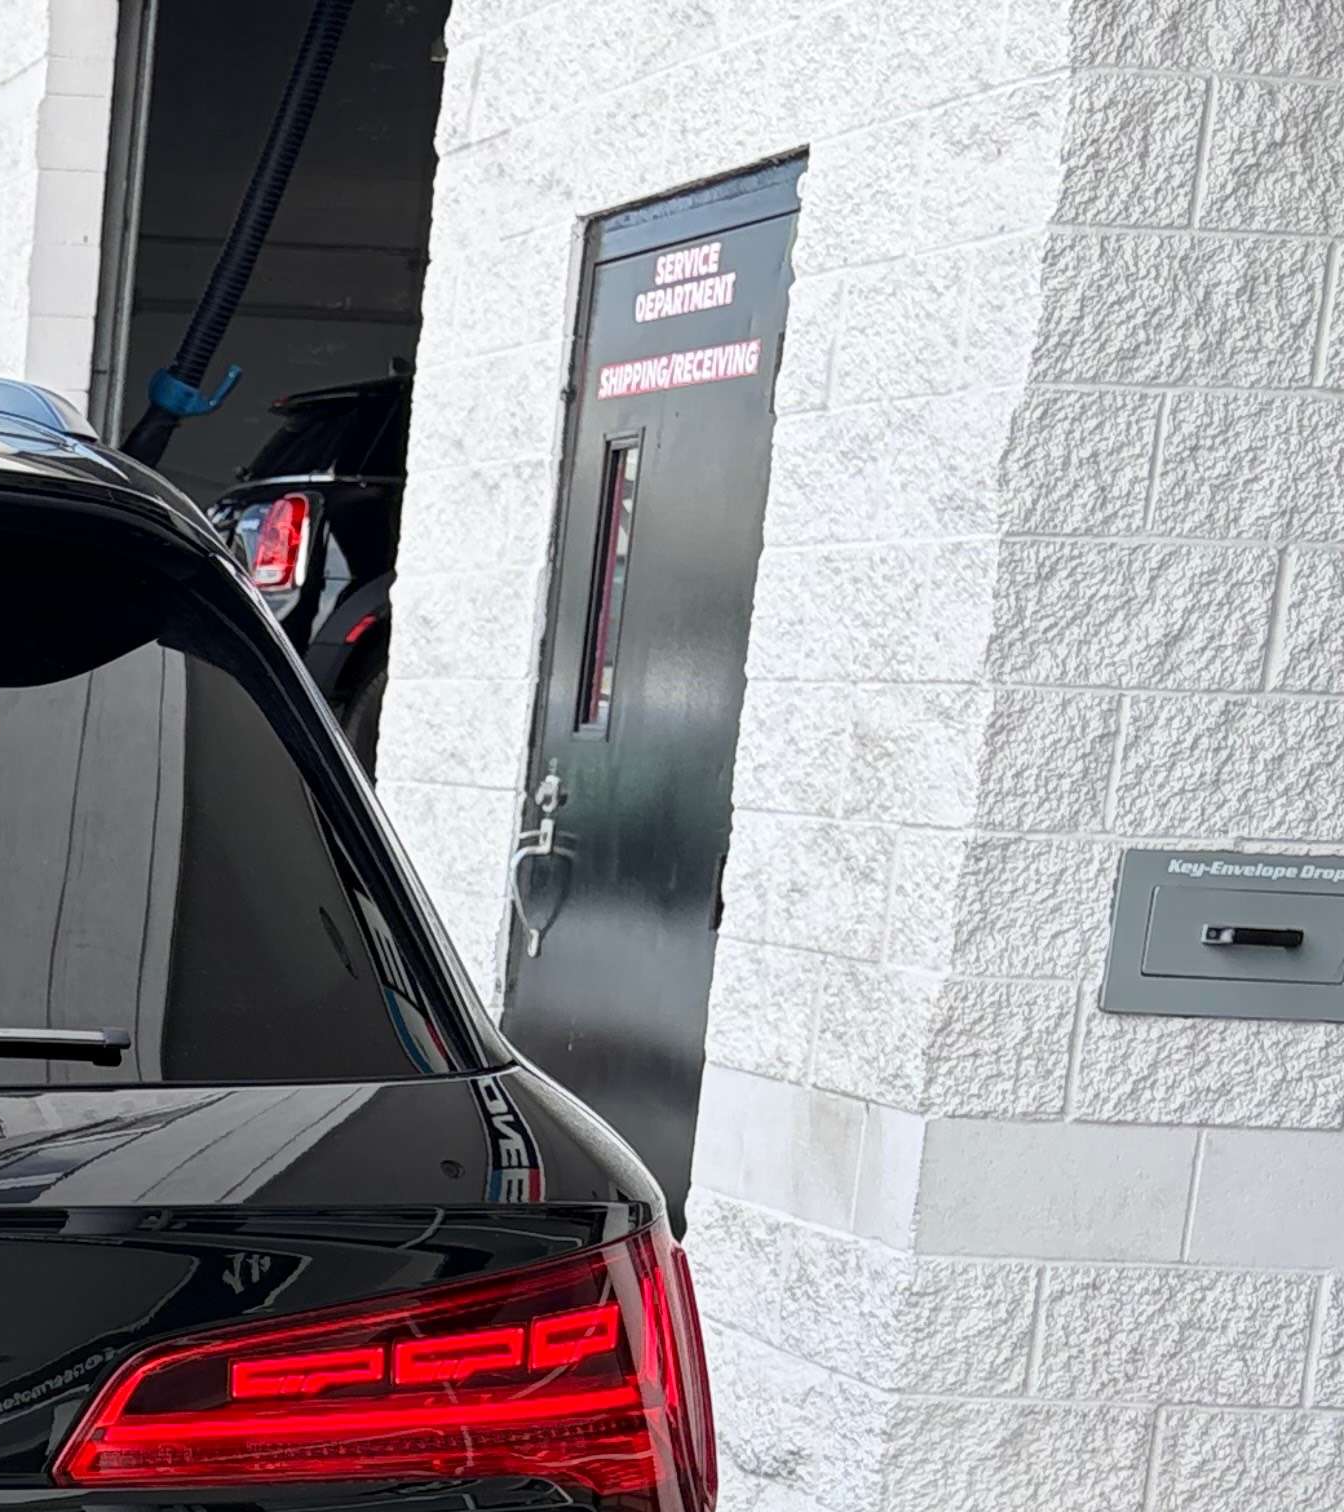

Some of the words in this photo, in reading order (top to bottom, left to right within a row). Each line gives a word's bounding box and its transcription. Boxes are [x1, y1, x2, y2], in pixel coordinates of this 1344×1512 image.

[655, 242, 722, 286] SERVICE
[635, 272, 737, 323] DEPARTMENT
[598, 341, 760, 399] SHIPPING/RECEIVING
[1167, 858, 1298, 879] Key-Envelope
[1299, 864, 1344, 882] Drop
